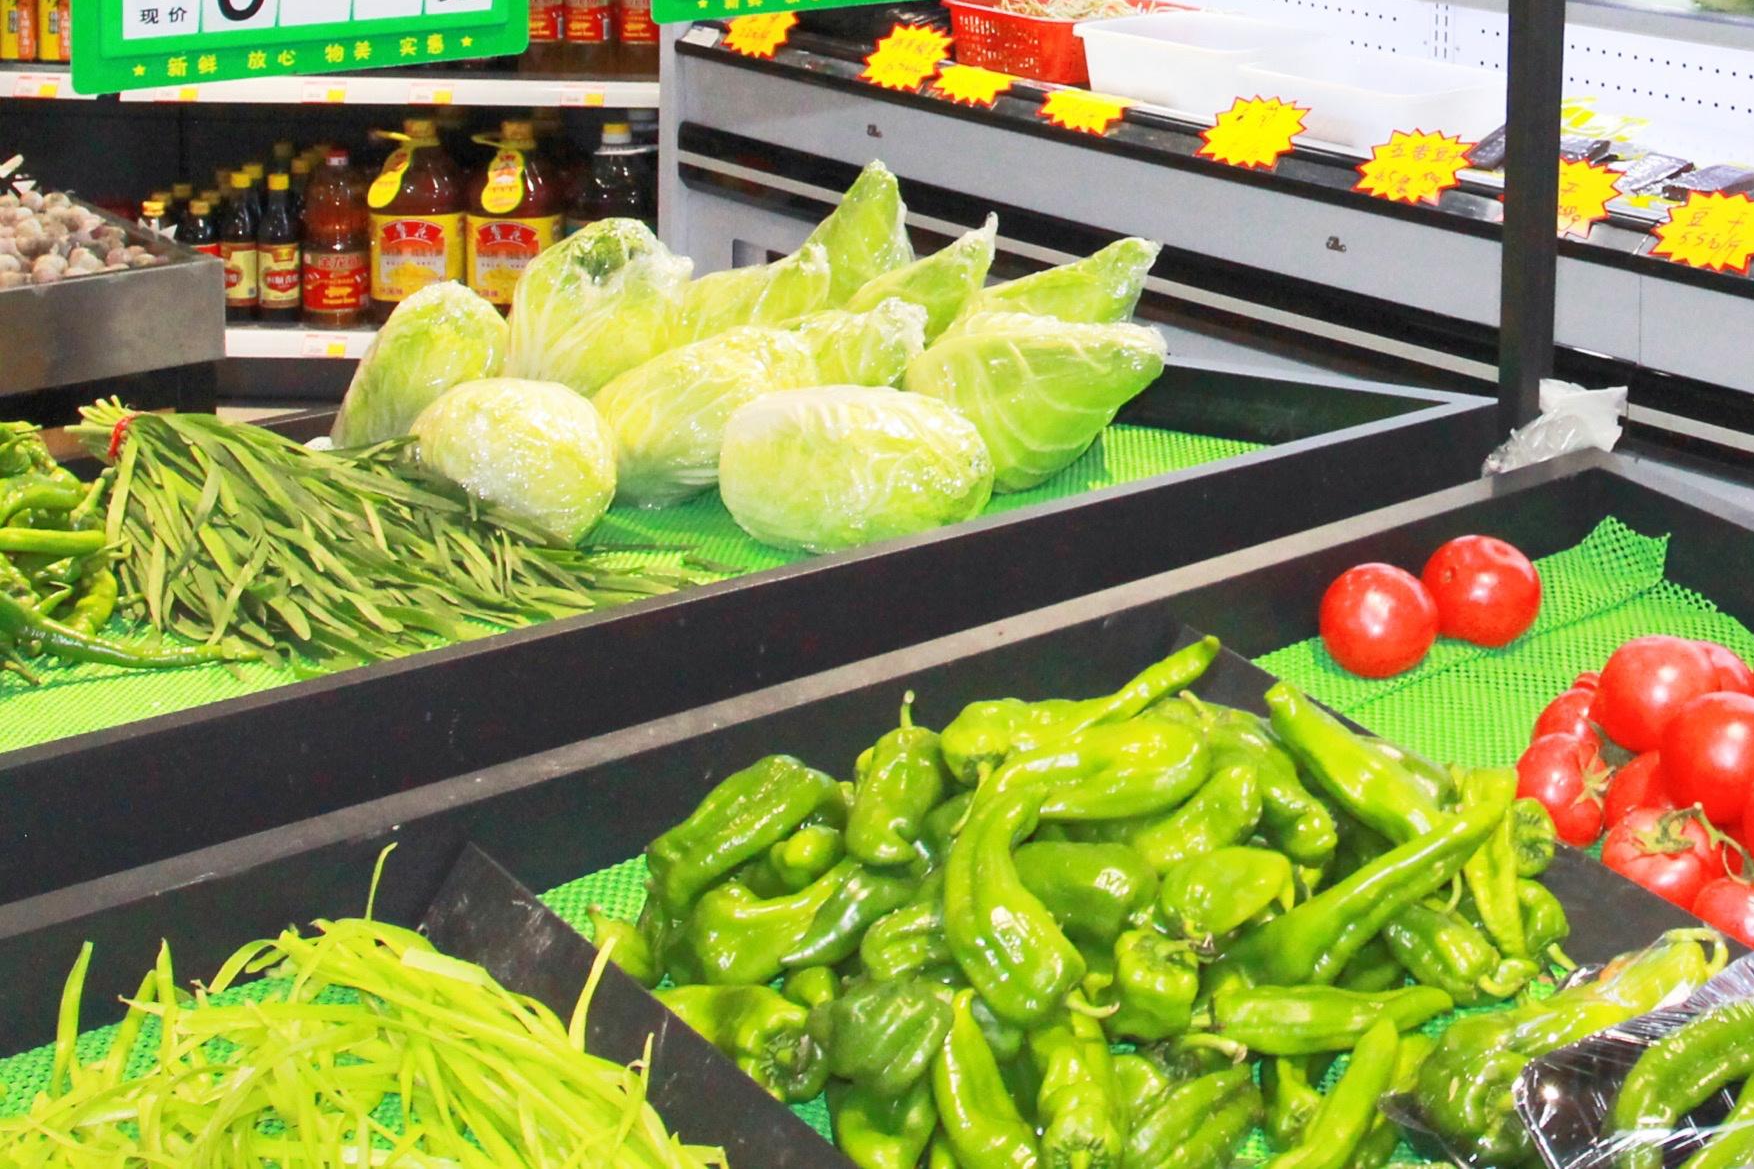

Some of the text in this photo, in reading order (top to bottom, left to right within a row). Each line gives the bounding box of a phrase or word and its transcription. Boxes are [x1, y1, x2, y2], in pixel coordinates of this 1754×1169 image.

[139, 7, 187, 24] 现价
[167, 56, 218, 77] 新鲜
[247, 49, 296, 69] 放心
[325, 41, 372, 63] 物美
